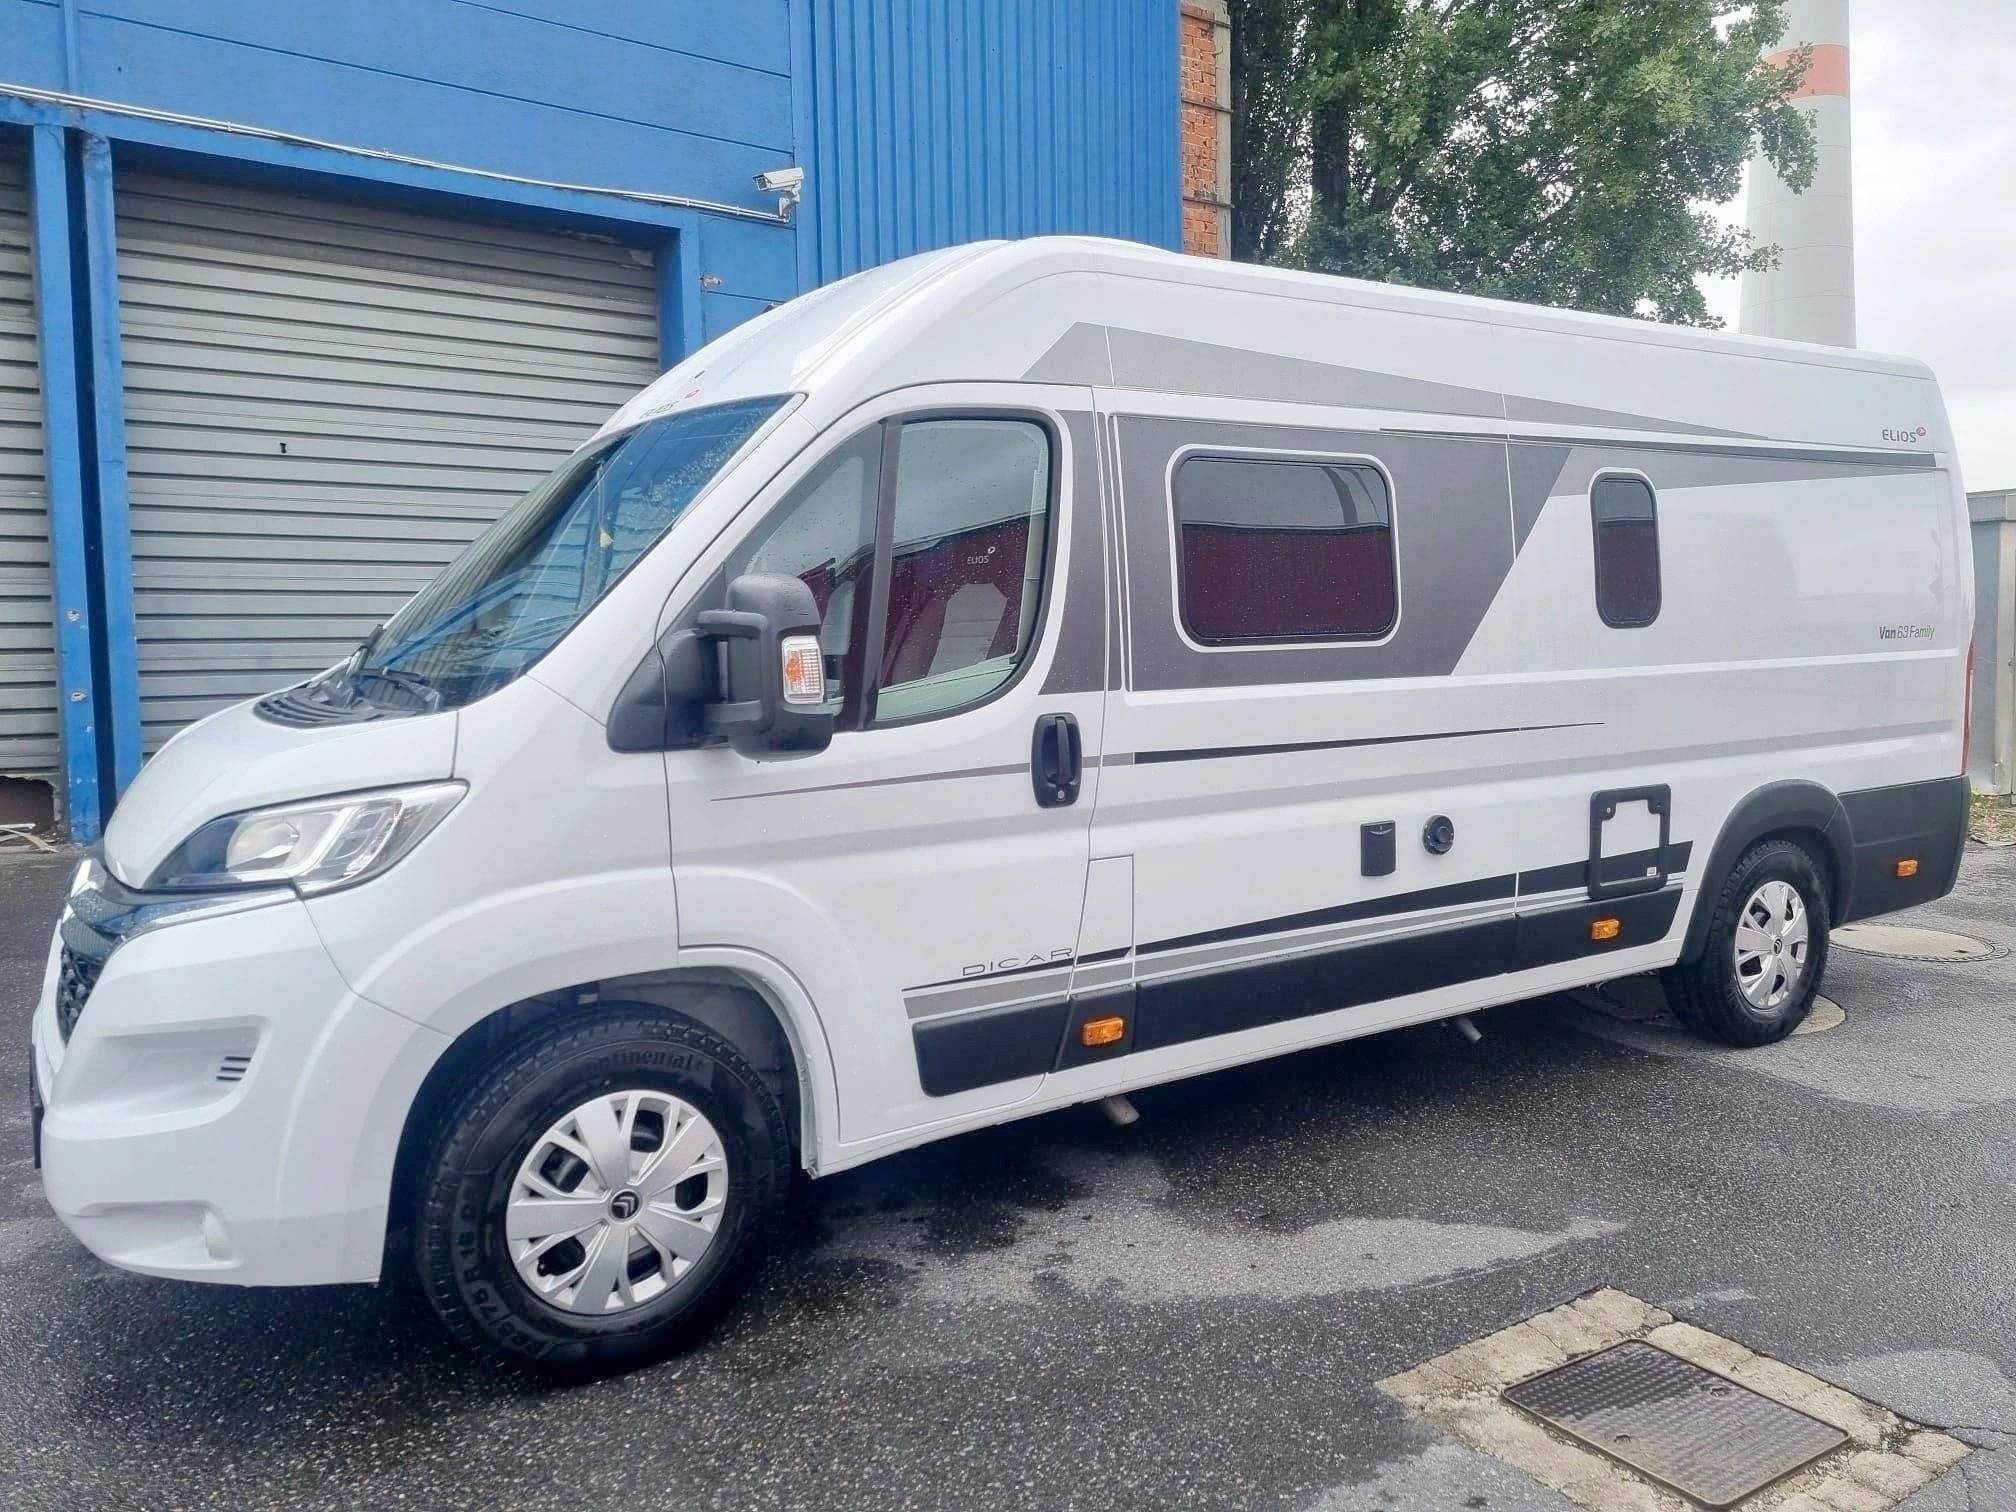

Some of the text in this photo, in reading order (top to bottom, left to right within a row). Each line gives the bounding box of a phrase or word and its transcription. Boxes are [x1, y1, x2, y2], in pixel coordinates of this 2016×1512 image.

[1882, 429, 1917, 443] ELIOS
[967, 555, 990, 565] ELIOS
[1879, 624, 1935, 641] Van 63 Family
[962, 947, 1073, 977] DICAR
[578, 1050, 693, 1077] ontinental
